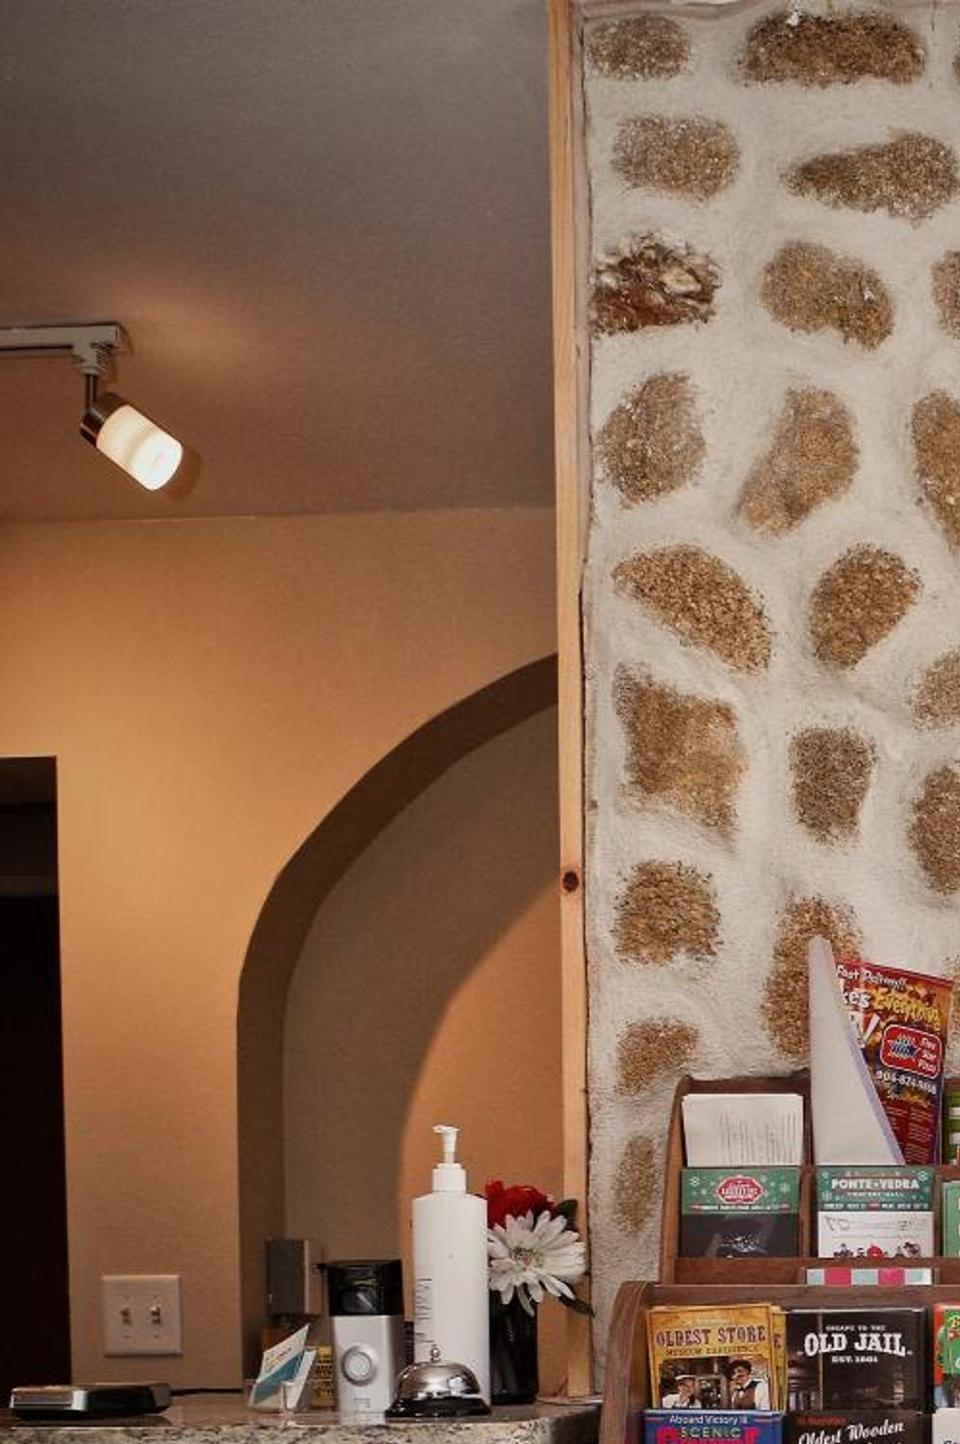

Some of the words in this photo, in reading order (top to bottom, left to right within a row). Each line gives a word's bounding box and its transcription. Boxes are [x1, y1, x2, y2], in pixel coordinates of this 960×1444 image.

[656, 1329, 711, 1347] OLDEST
[718, 1324, 766, 1344] STORE
[804, 1333, 848, 1357] OLD
[854, 1333, 906, 1357] JAIL
[680, 1426, 741, 1438] SCENIC
[846, 1418, 905, 1441] Wooden
